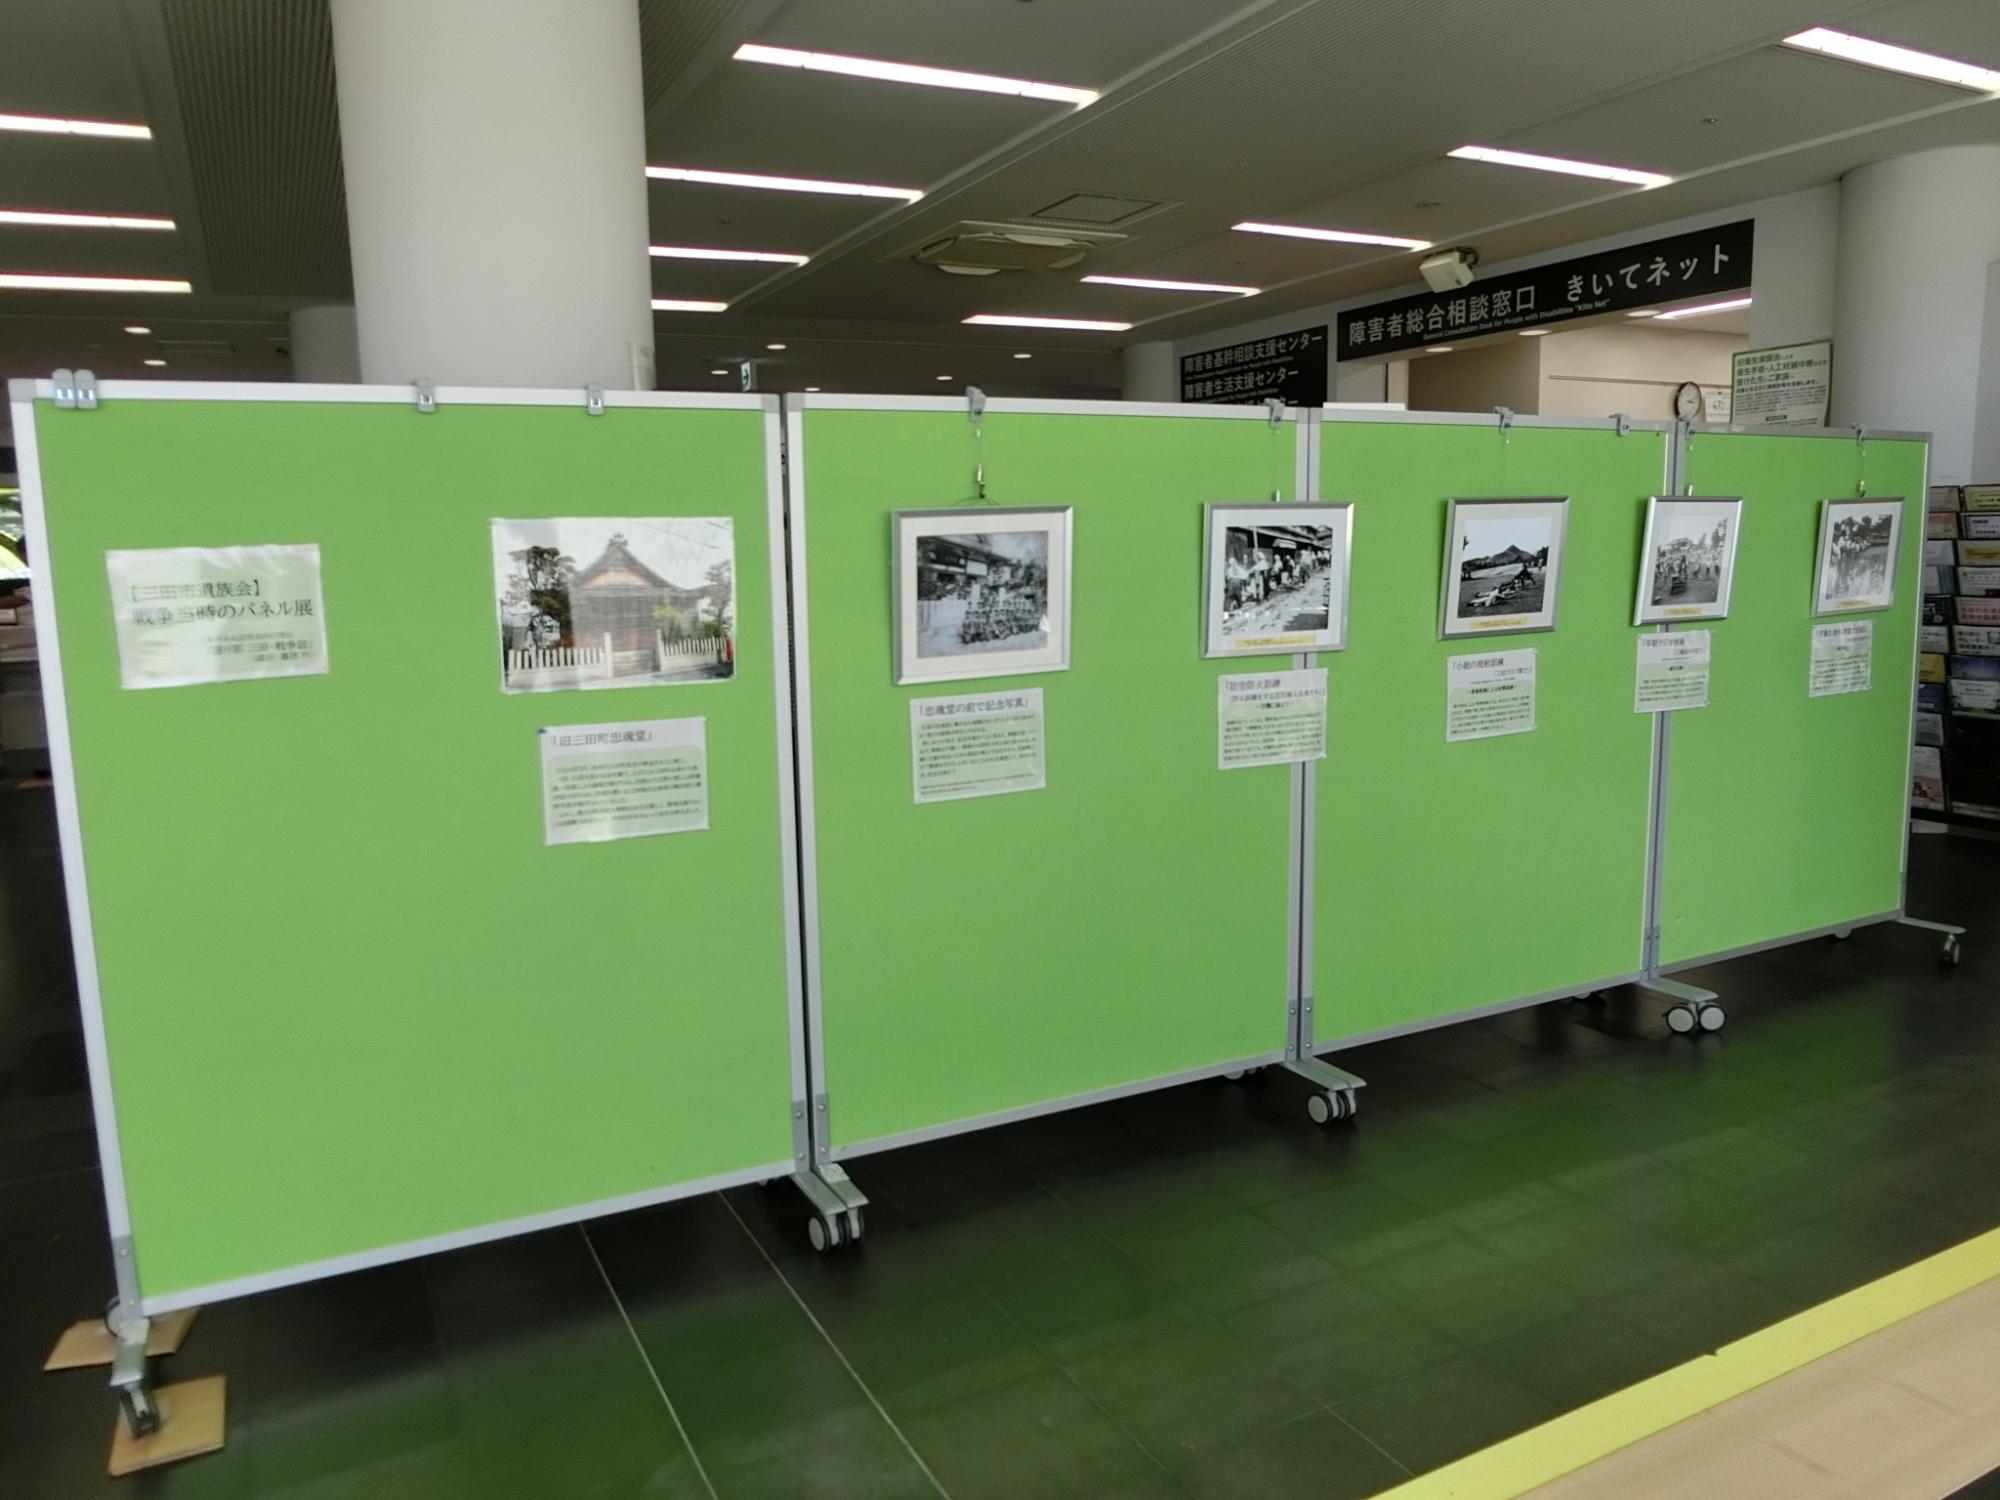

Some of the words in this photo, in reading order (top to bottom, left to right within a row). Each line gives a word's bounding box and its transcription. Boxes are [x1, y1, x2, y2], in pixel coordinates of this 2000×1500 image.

[1349, 285, 1535, 346] 障害者総合相談窓口
[1566, 244, 1730, 302] きいてネット
[1184, 333, 1322, 374] 障害者基幹相談支援センター
[1184, 367, 1299, 400] 障害者生活支援センター
[130, 578, 260, 602] 【三田市遺族会】
[132, 598, 314, 626] 戦争当時のパネル展
[552, 729, 653, 747] 「旧三田町忠魂堂」
